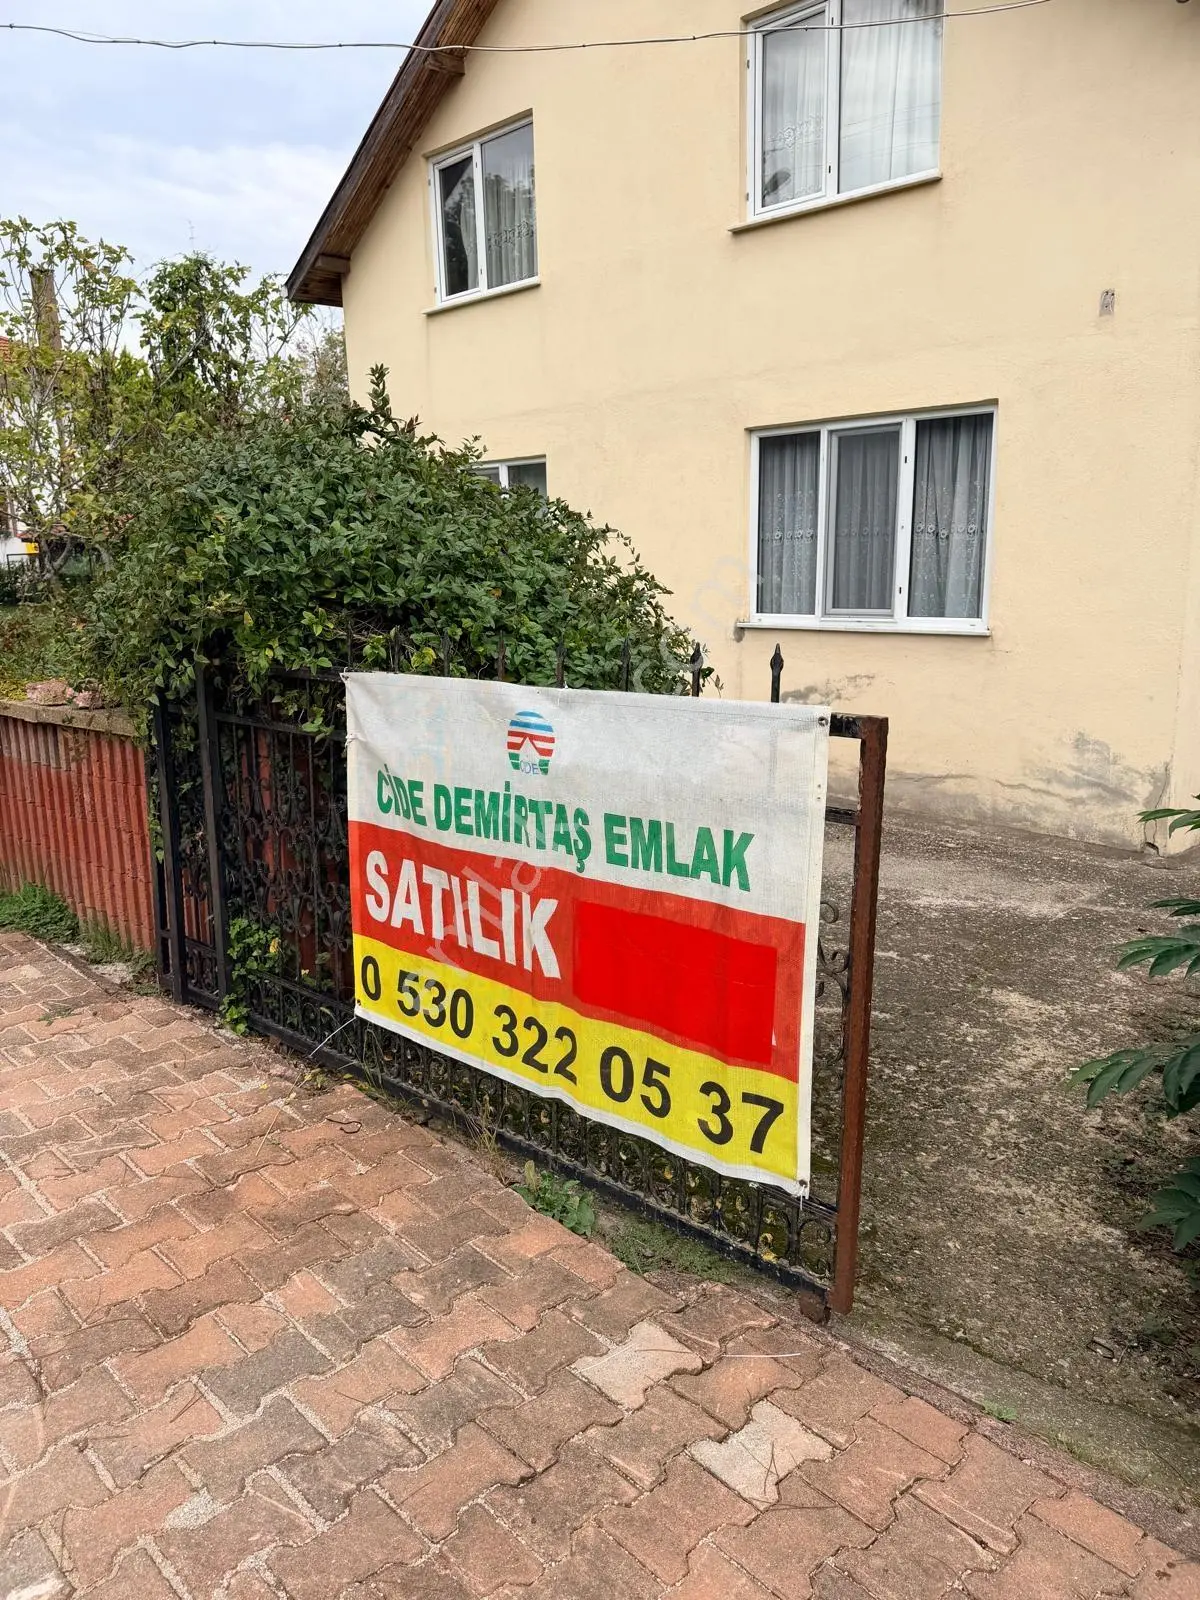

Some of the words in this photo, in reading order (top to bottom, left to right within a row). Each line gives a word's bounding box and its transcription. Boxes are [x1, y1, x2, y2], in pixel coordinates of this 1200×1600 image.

[376, 763, 427, 828] CİDE
[433, 780, 593, 873] DEMİRTAŞ
[602, 812, 754, 893] EMLAK
[365, 850, 562, 980] SATILIK
[361, 955, 382, 1002] 0
[397, 969, 474, 1039] 530
[491, 1004, 579, 1086] 322
[599, 1045, 672, 1119] 05
[697, 1080, 785, 1154] 37
